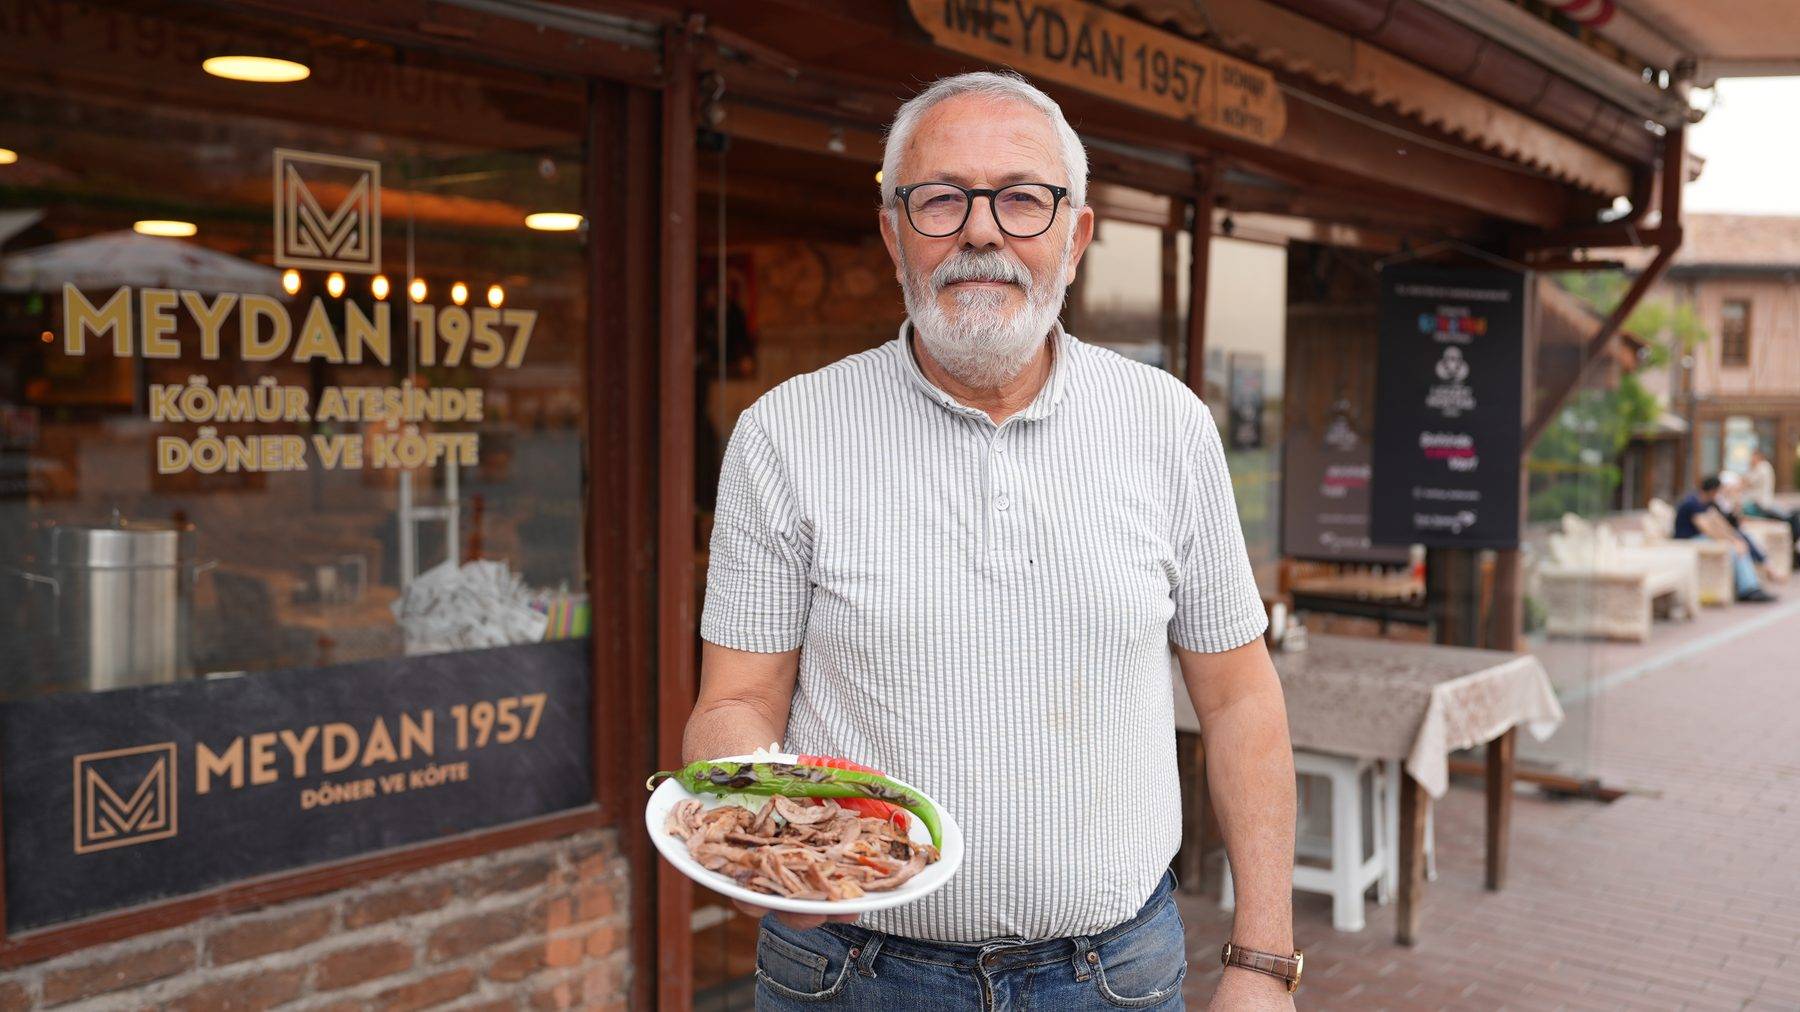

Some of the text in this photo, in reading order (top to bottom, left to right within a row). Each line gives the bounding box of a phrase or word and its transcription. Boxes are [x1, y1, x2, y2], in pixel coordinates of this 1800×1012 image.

[944, 0, 1206, 112] MEYDAN 1957
[63, 282, 538, 369] MEYDAN 1957
[149, 374, 484, 430] KÖMÜR ATEŞİNDE
[157, 424, 480, 474] DÖNER VE KÖFTE
[195, 693, 548, 795] MEYDAN 1957
[300, 761, 470, 811] DÖNER VE KÖFTE
